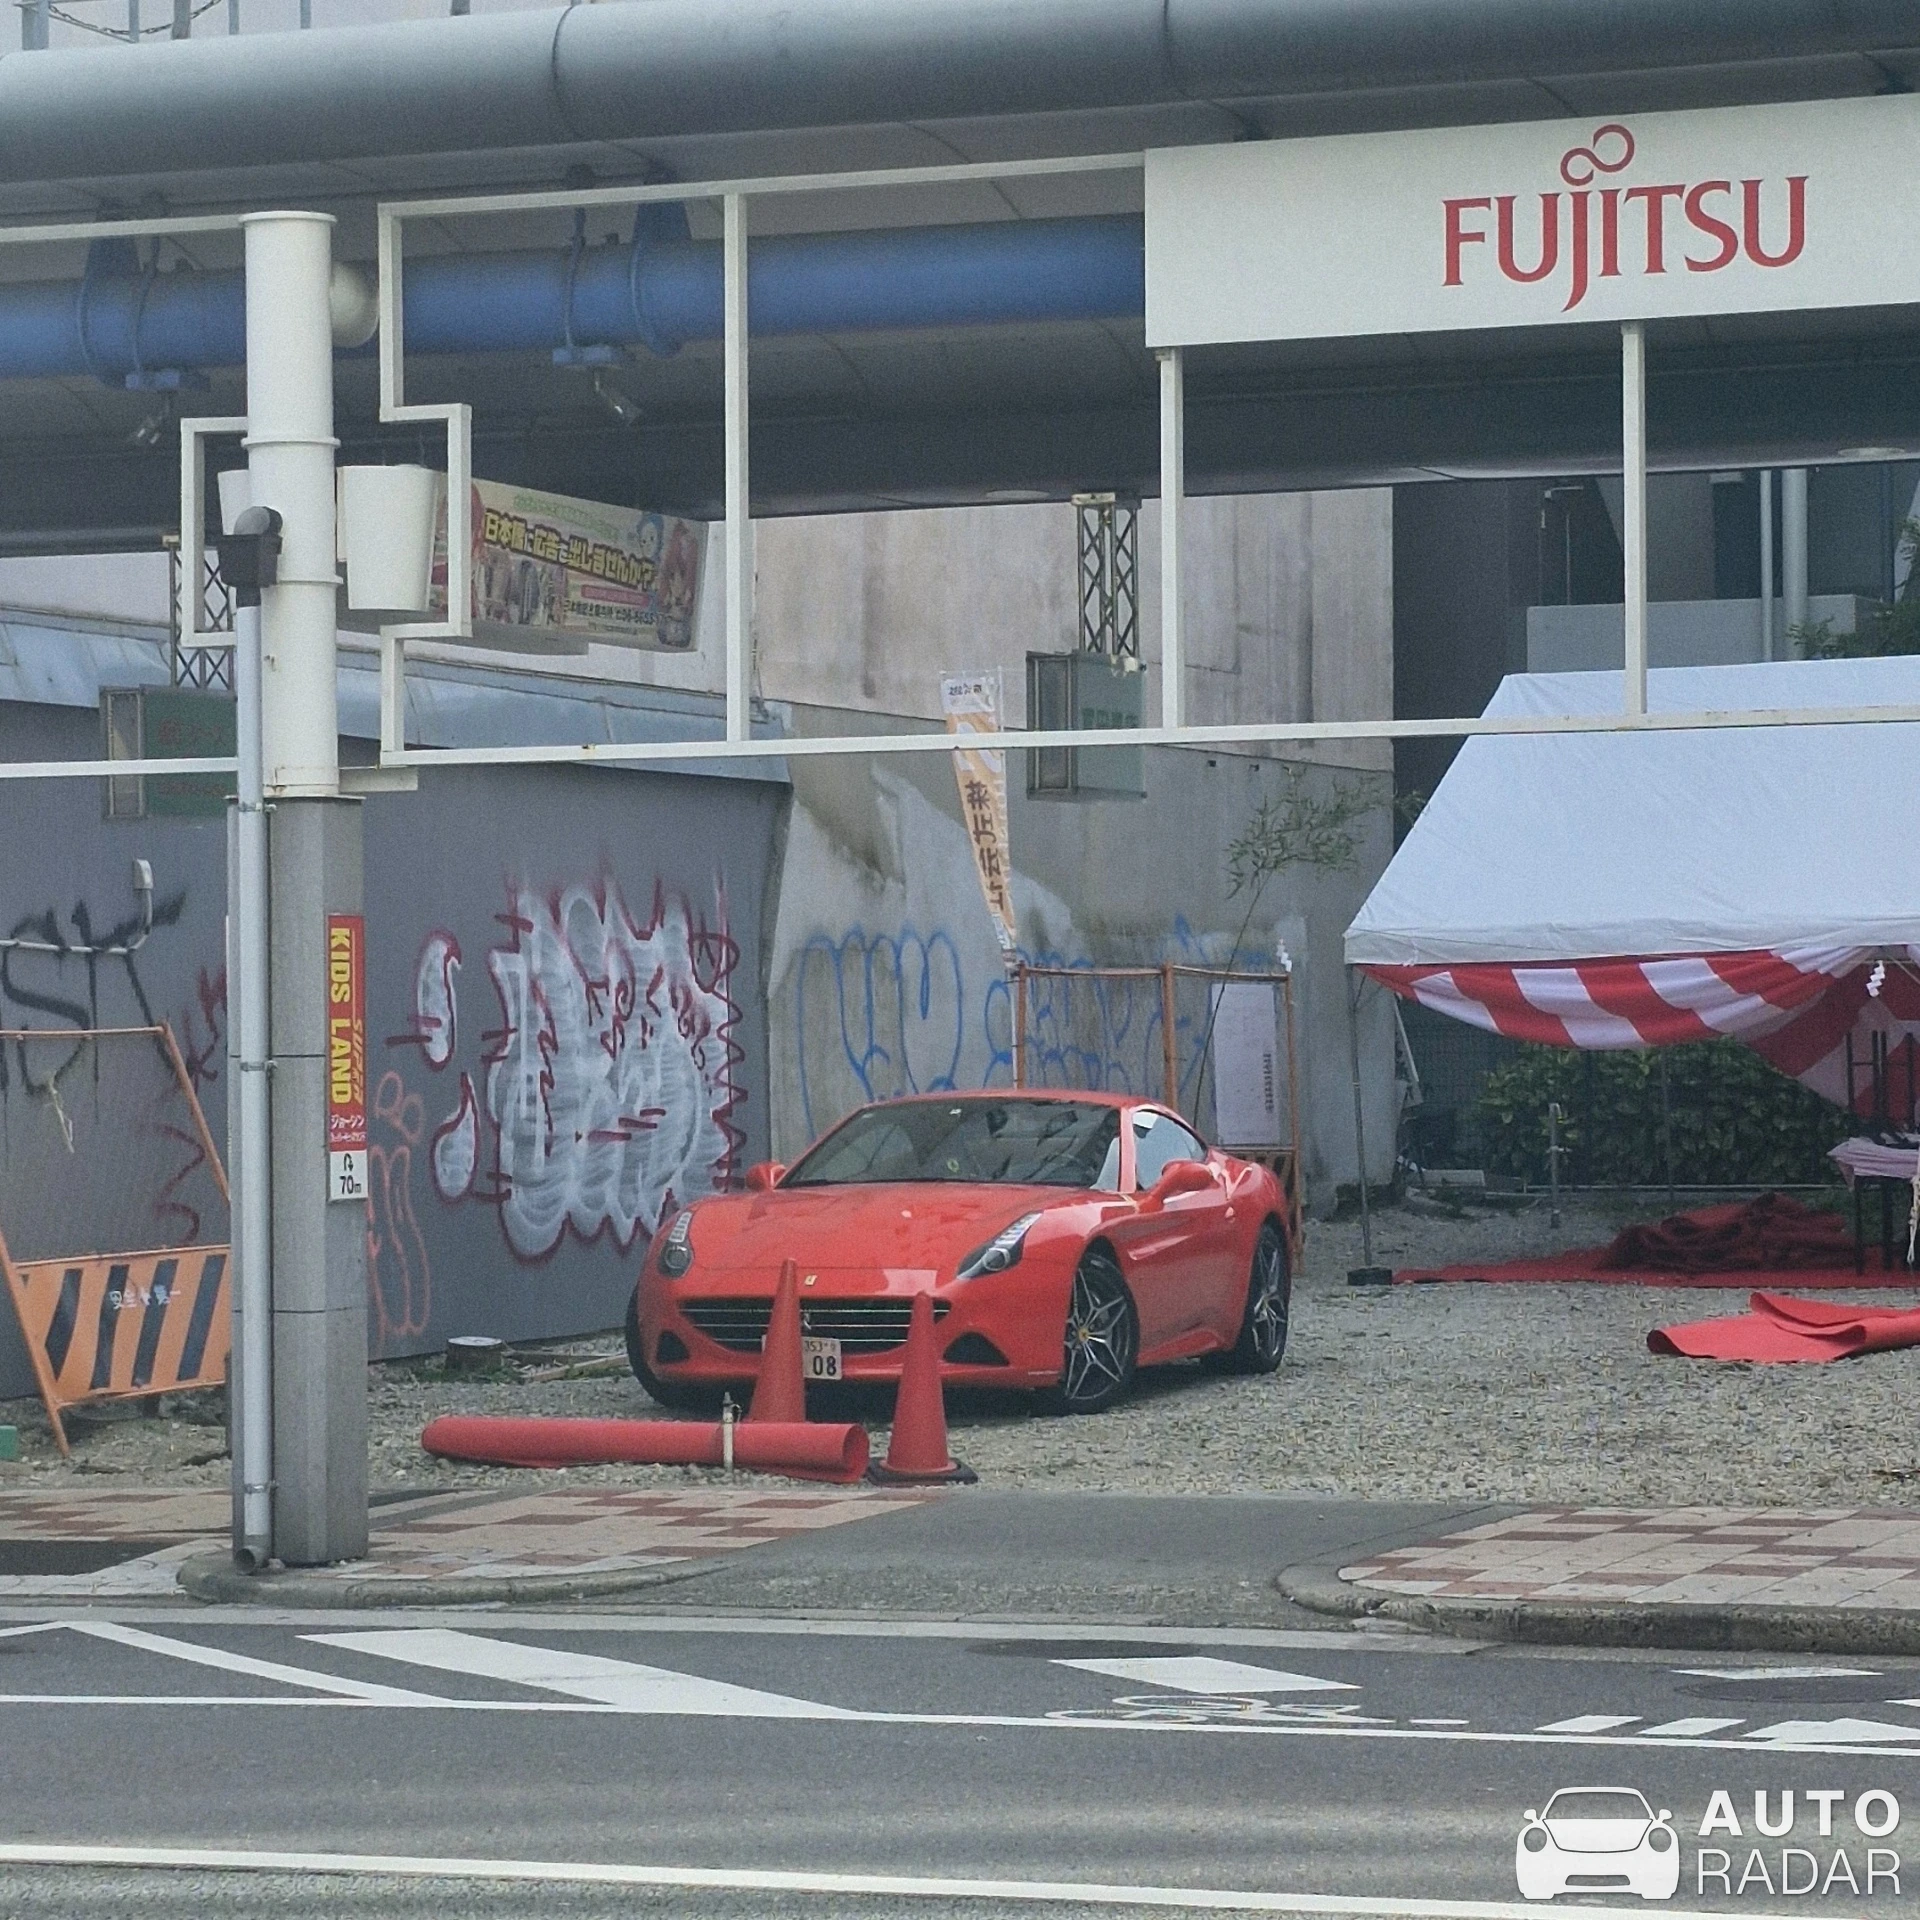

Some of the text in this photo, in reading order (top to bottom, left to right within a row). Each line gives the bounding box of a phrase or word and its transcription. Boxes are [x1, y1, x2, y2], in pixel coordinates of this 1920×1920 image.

[1442, 124, 1809, 312] FUJITSU
[331, 928, 351, 1104] KIDS LAND
[339, 1175, 362, 1195] 70m
[813, 1355, 837, 1377] 08
